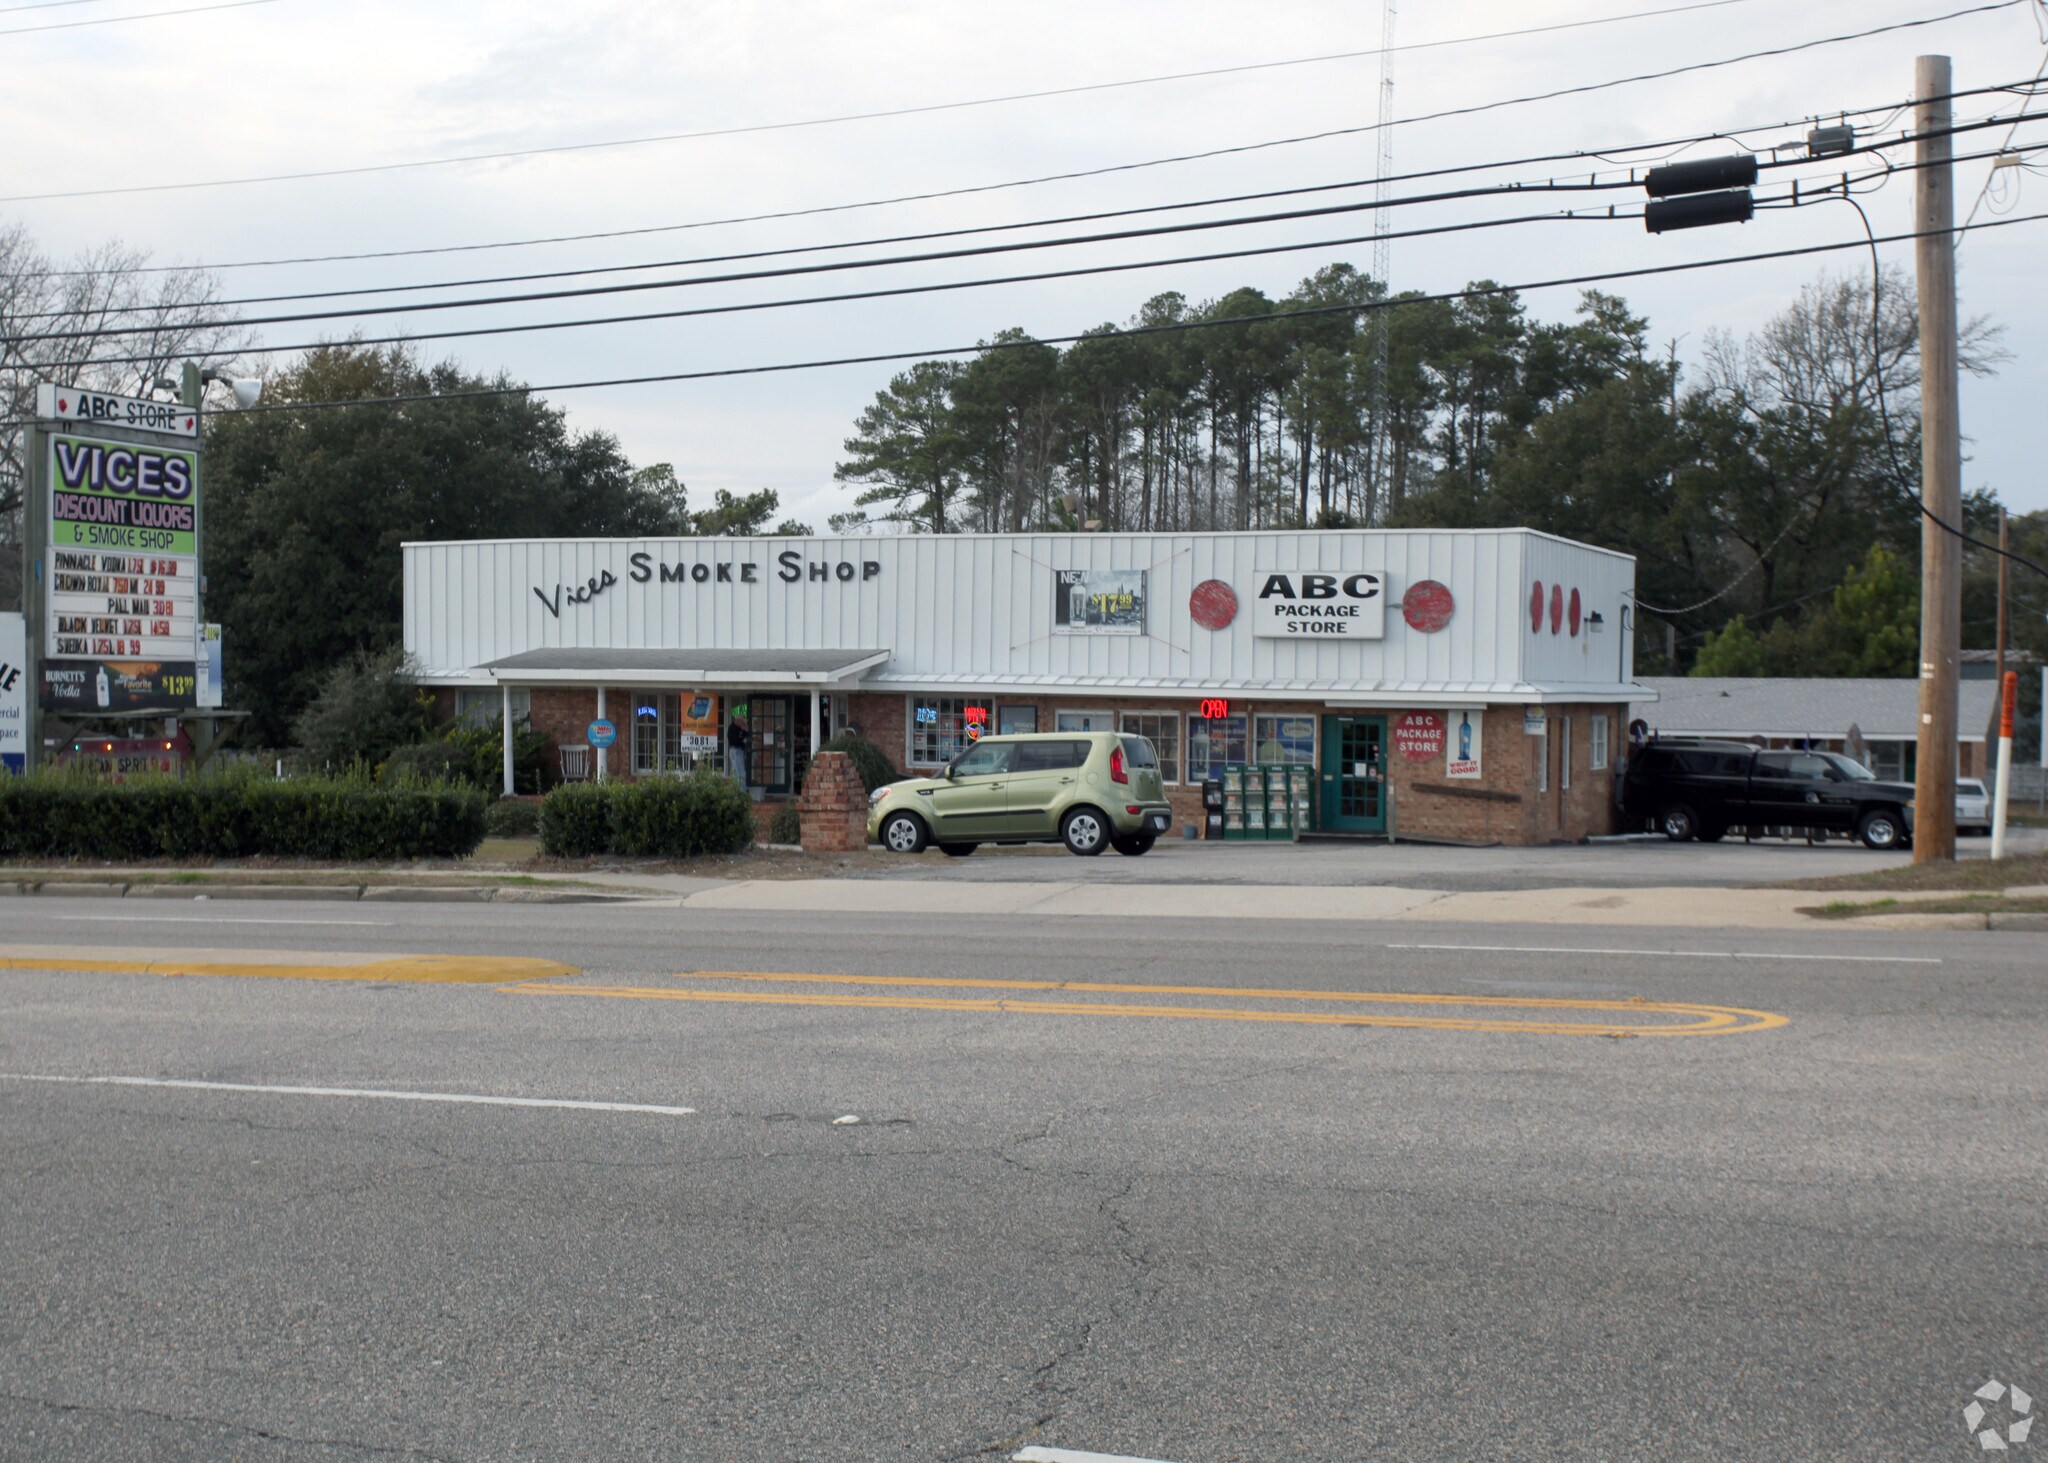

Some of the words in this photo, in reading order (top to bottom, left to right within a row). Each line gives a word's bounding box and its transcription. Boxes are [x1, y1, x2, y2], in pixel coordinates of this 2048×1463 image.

[77, 394, 119, 422] ABC
[127, 402, 177, 430] STORE
[56, 441, 190, 498] VICES
[54, 493, 128, 524] DISCOUNT
[131, 502, 192, 530] LIQUORS
[74, 524, 84, 543] &
[89, 525, 135, 547] SMOKE
[139, 530, 174, 549] SHOP
[55, 552, 97, 571] PINNACLE
[101, 555, 126, 573] VODKA
[54, 573, 86, 592] CROWN
[533, 569, 618, 618] Vices
[630, 552, 757, 583] SMOKE
[778, 551, 880, 583] SHOP
[1060, 571, 1089, 584] NEW
[1259, 574, 1379, 599] ABC
[107, 598, 130, 614] PALL
[1275, 604, 1360, 617] PACKAGE
[58, 616, 87, 634] BLACK
[91, 618, 118, 634] VELVET
[1287, 621, 1347, 634] STORE
[57, 637, 88, 654] SVEDKA
[51, 682, 81, 698] Vodka
[1201, 699, 1228, 719] OPEN
[1405, 716, 1434, 726] ABC
[1396, 729, 1442, 740] PACKAGE
[1400, 741, 1438, 752] STORE
[1450, 766, 1479, 775] GOOD!
